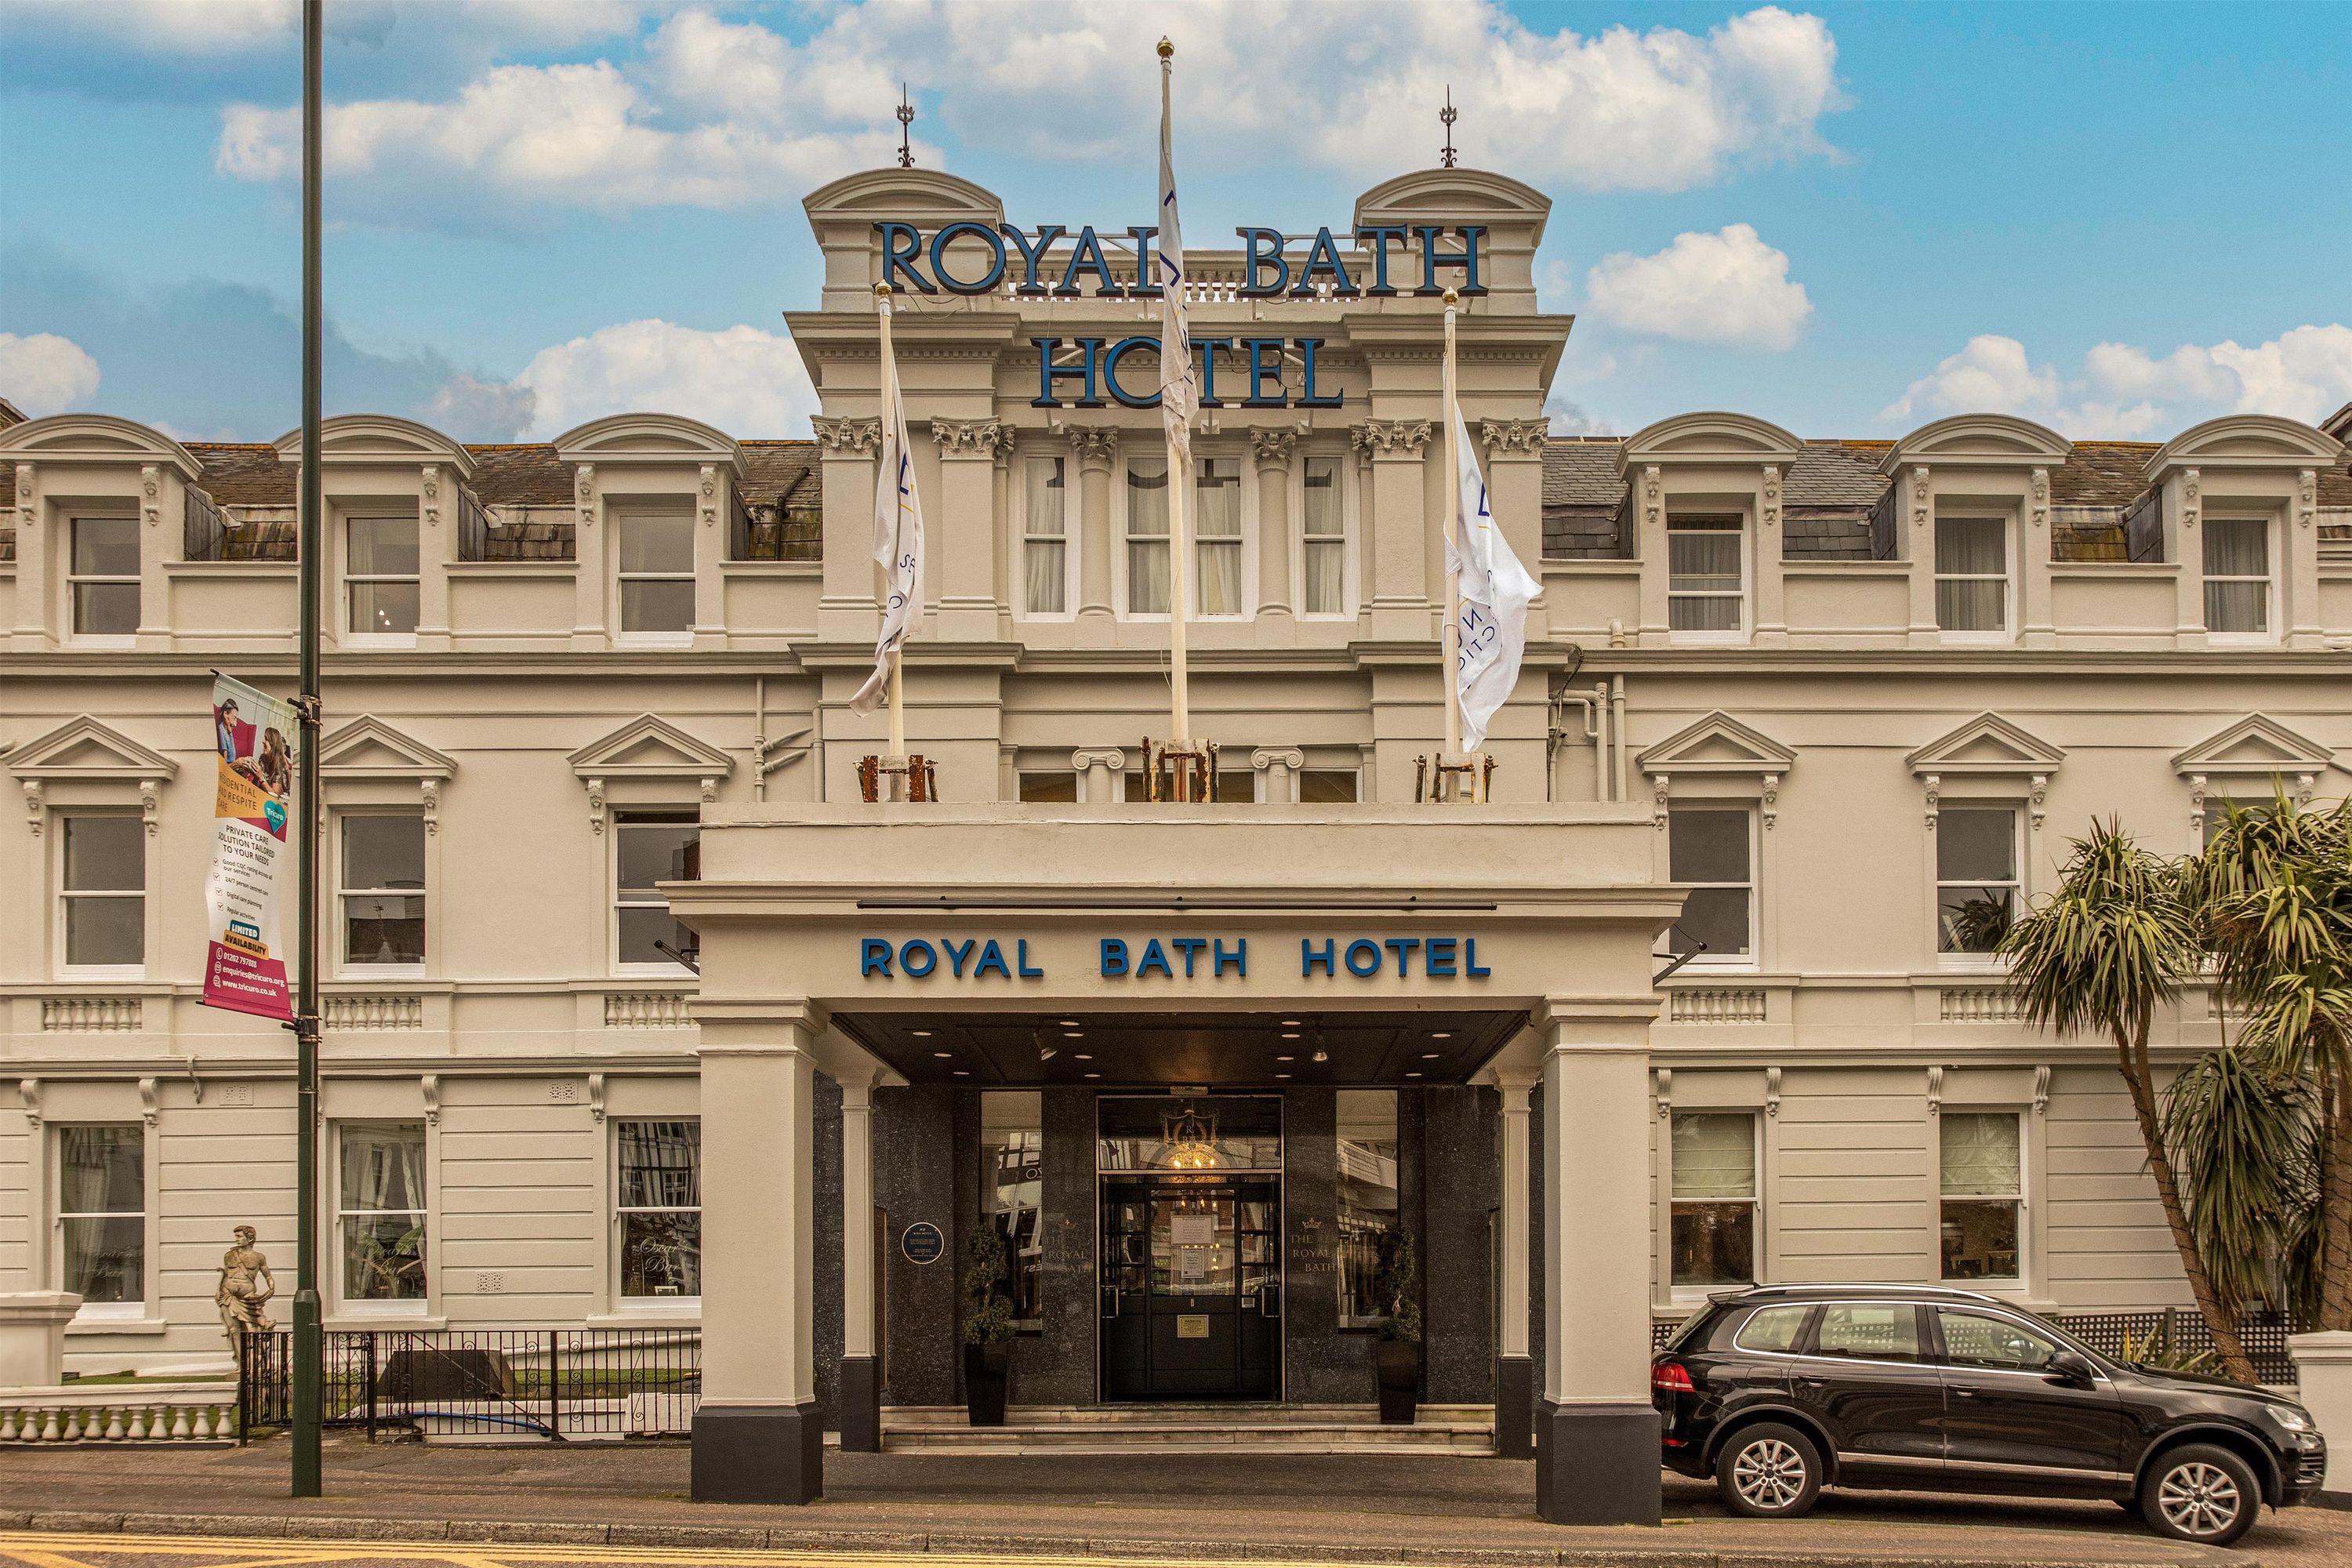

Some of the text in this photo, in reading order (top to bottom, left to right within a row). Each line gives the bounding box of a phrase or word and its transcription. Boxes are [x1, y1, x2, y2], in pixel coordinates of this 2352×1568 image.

[873, 222, 1487, 298] ROYAL BATH
[1030, 336, 1344, 409] HOTEL
[220, 771, 256, 798] RESIDENTIAL
[218, 797, 228, 812] CARE
[227, 792, 257, 811] RESPITE
[267, 808, 284, 821] Tricuro
[226, 825, 269, 845] PRIVATE CARE
[218, 832, 275, 858] SOLUTION TAILORED
[223, 844, 269, 866] TO YOUR NEEDS
[223, 858, 236, 867] Good
[247, 866, 258, 875] rating
[233, 869, 251, 877] services
[227, 891, 239, 900] Digital
[247, 899, 263, 910] planning
[227, 906, 256, 921] Regular activities
[231, 924, 258, 938] LIMITED
[224, 934, 267, 956] AVAILABILITY
[223, 952, 239, 963] 01202
[861, 938, 1491, 978] ROYAL BATH HOTEL
[223, 966, 285, 988] enquiries@tricuro.org
[222, 980, 278, 996] www.tricuro.co.uk
[640, 1236, 688, 1254] Oscar's
[1289, 1235, 1313, 1244] THE
[1048, 1250, 1085, 1259] ROYAL
[1293, 1249, 1330, 1258] ROYAL
[645, 1255, 681, 1272] Bar
[1305, 1262, 1335, 1272] BATH
